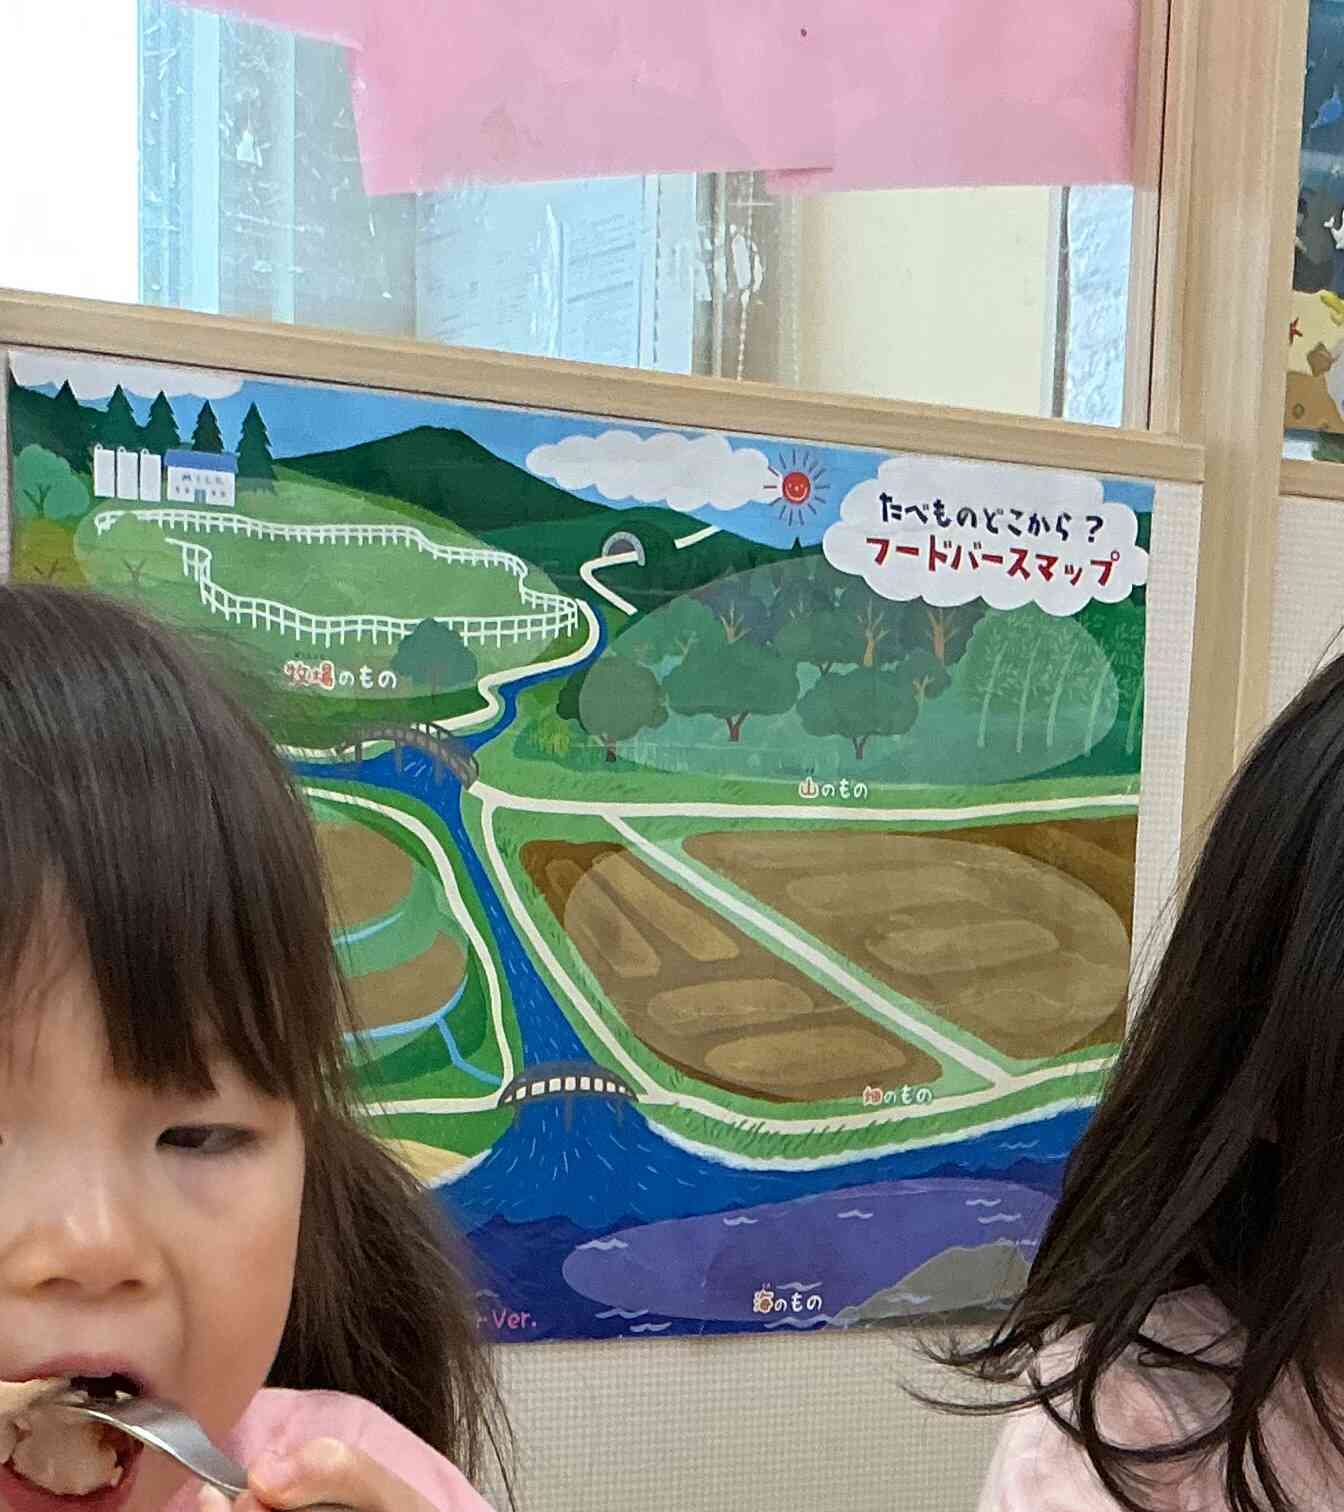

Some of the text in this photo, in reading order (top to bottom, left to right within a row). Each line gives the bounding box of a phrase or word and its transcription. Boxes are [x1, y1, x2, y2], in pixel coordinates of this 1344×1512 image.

[878, 491, 1105, 544] たべものどこから？
[865, 534, 1121, 587] フードバースマップ
[798, 776, 868, 800] 山のもの
